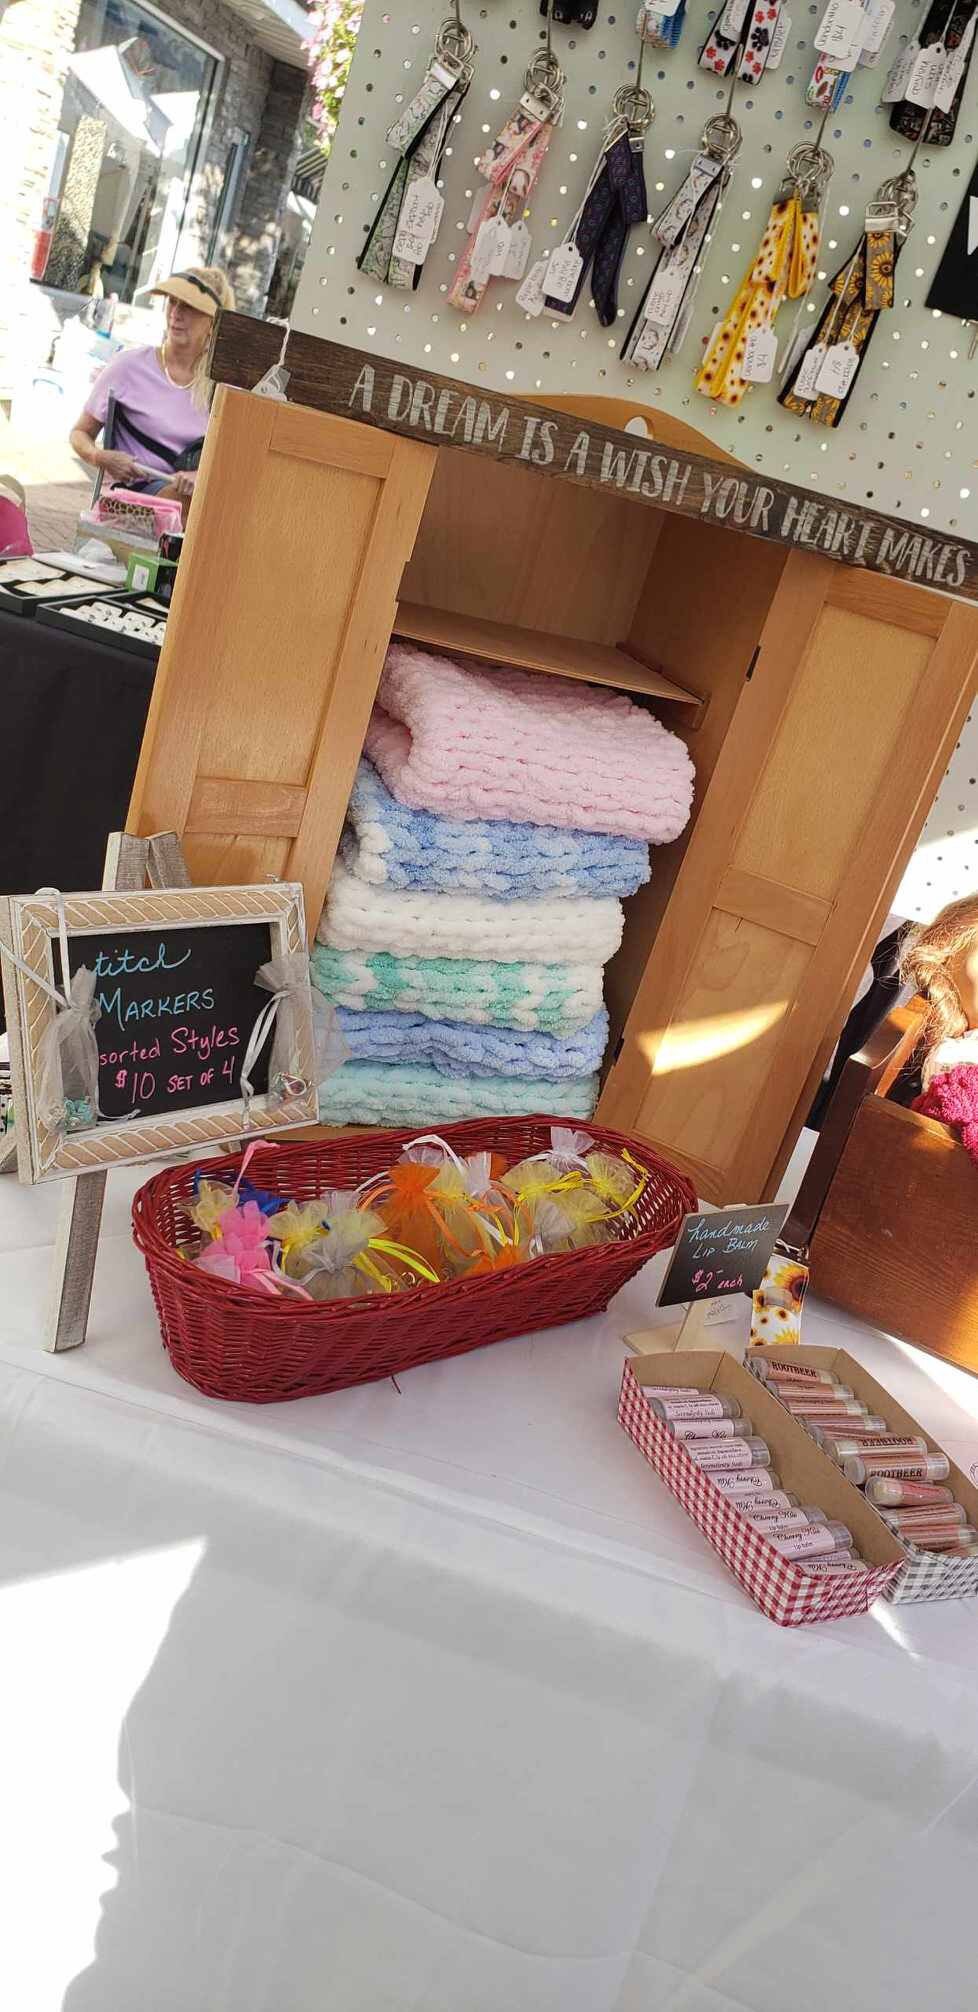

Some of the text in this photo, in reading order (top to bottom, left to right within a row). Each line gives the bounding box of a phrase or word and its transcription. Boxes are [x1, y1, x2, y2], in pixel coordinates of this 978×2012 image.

[348, 363, 972, 587] A DREAM IS A WISH YOUR HEART MAKES
[94, 942, 191, 977] titch
[98, 986, 215, 1031] MARKERS
[170, 1025, 241, 1061] Styles
[114, 1055, 235, 1104] $10 SET OF 4
[688, 1216, 770, 1243] handmade
[717, 1274, 743, 1289] each
[770, 1361, 817, 1378] ROOTBEER
